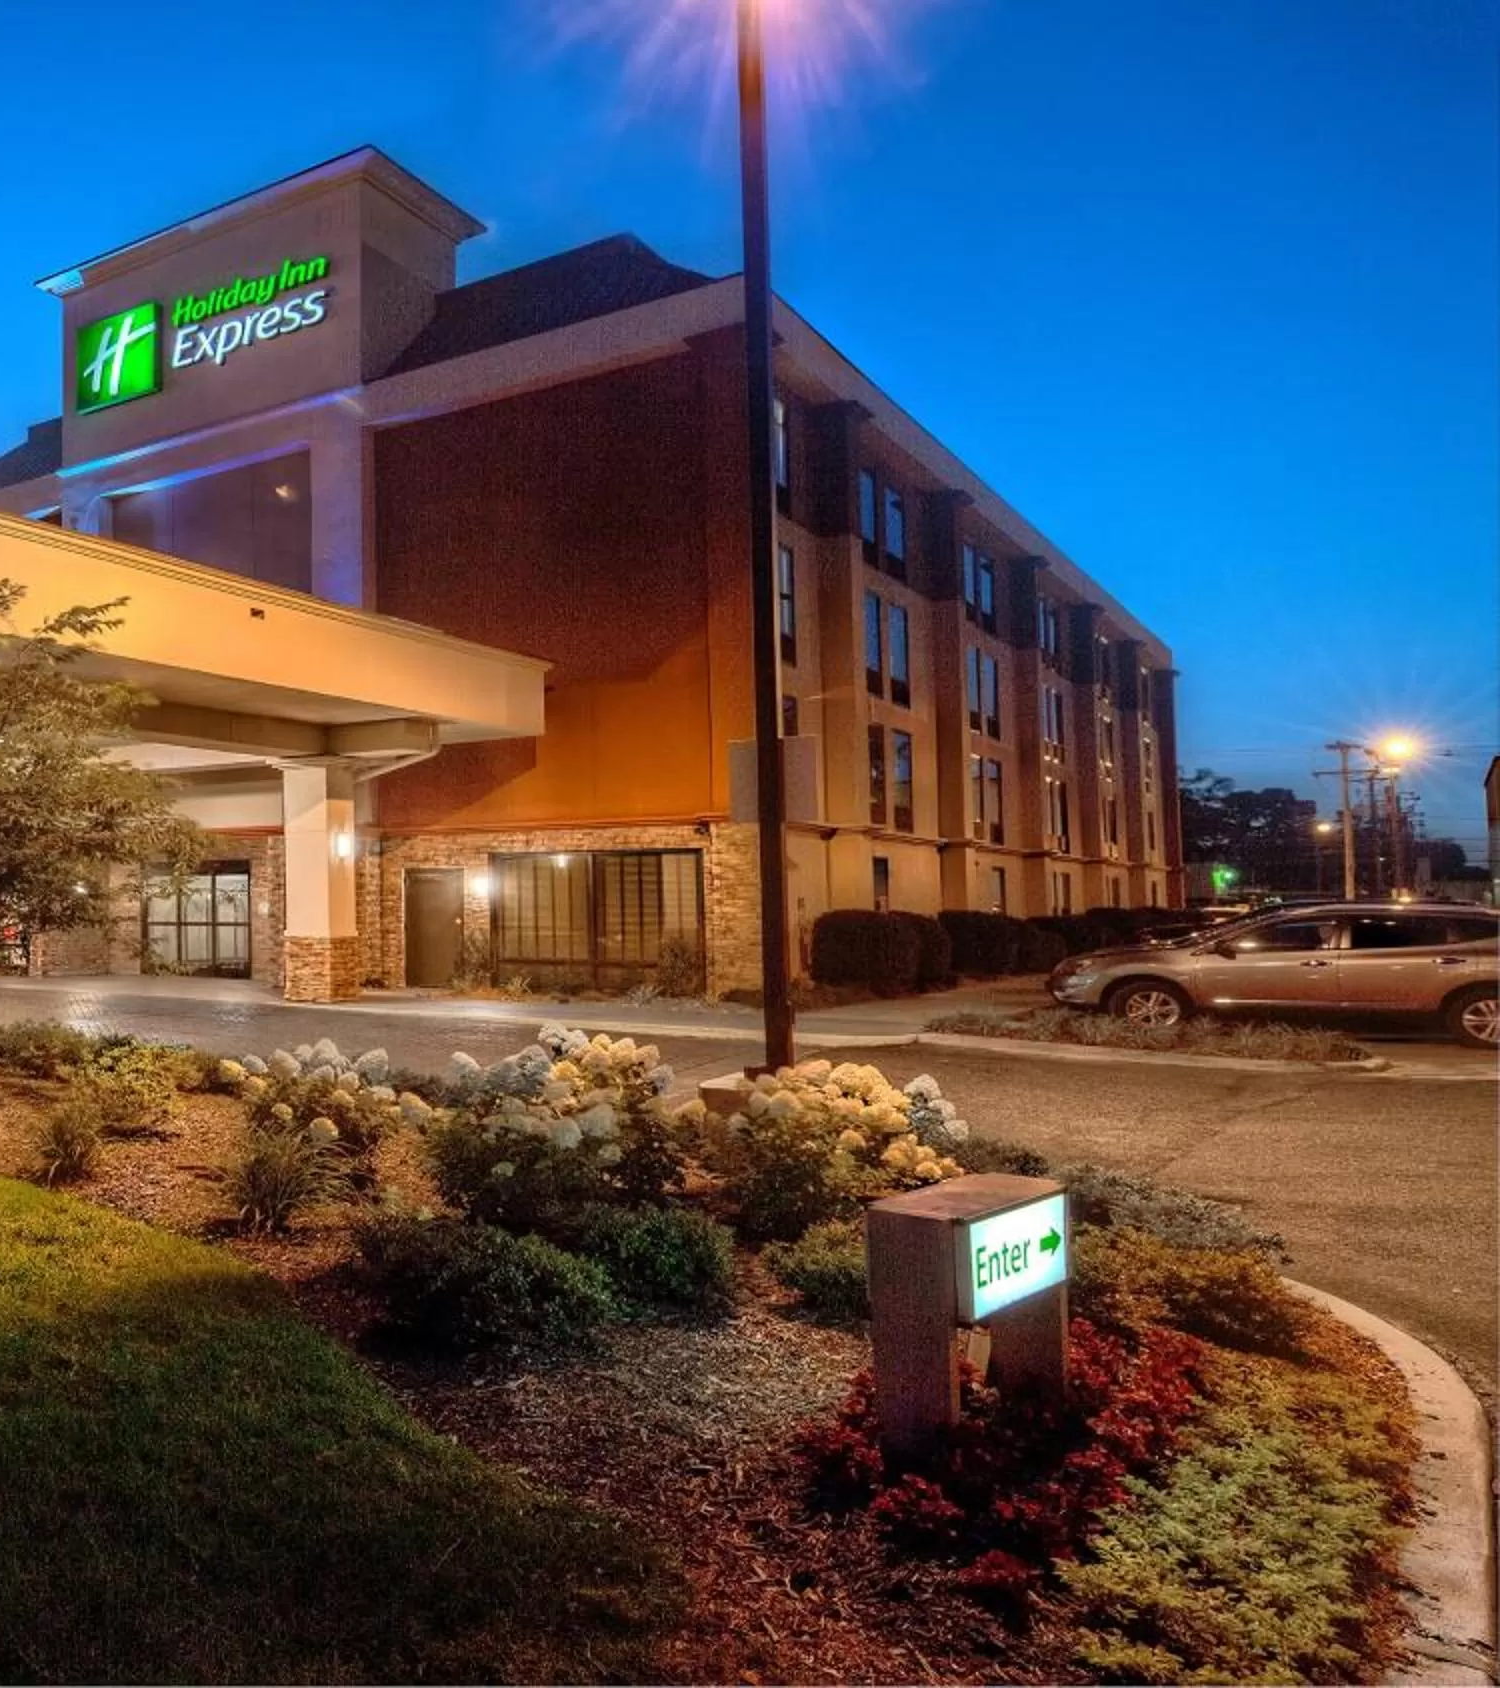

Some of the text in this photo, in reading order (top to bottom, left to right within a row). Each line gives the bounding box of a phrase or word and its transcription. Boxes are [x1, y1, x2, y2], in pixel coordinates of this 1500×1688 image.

[172, 255, 327, 327] Holiday Inn
[171, 290, 327, 367] Express
[976, 1238, 1031, 1288] Enter
